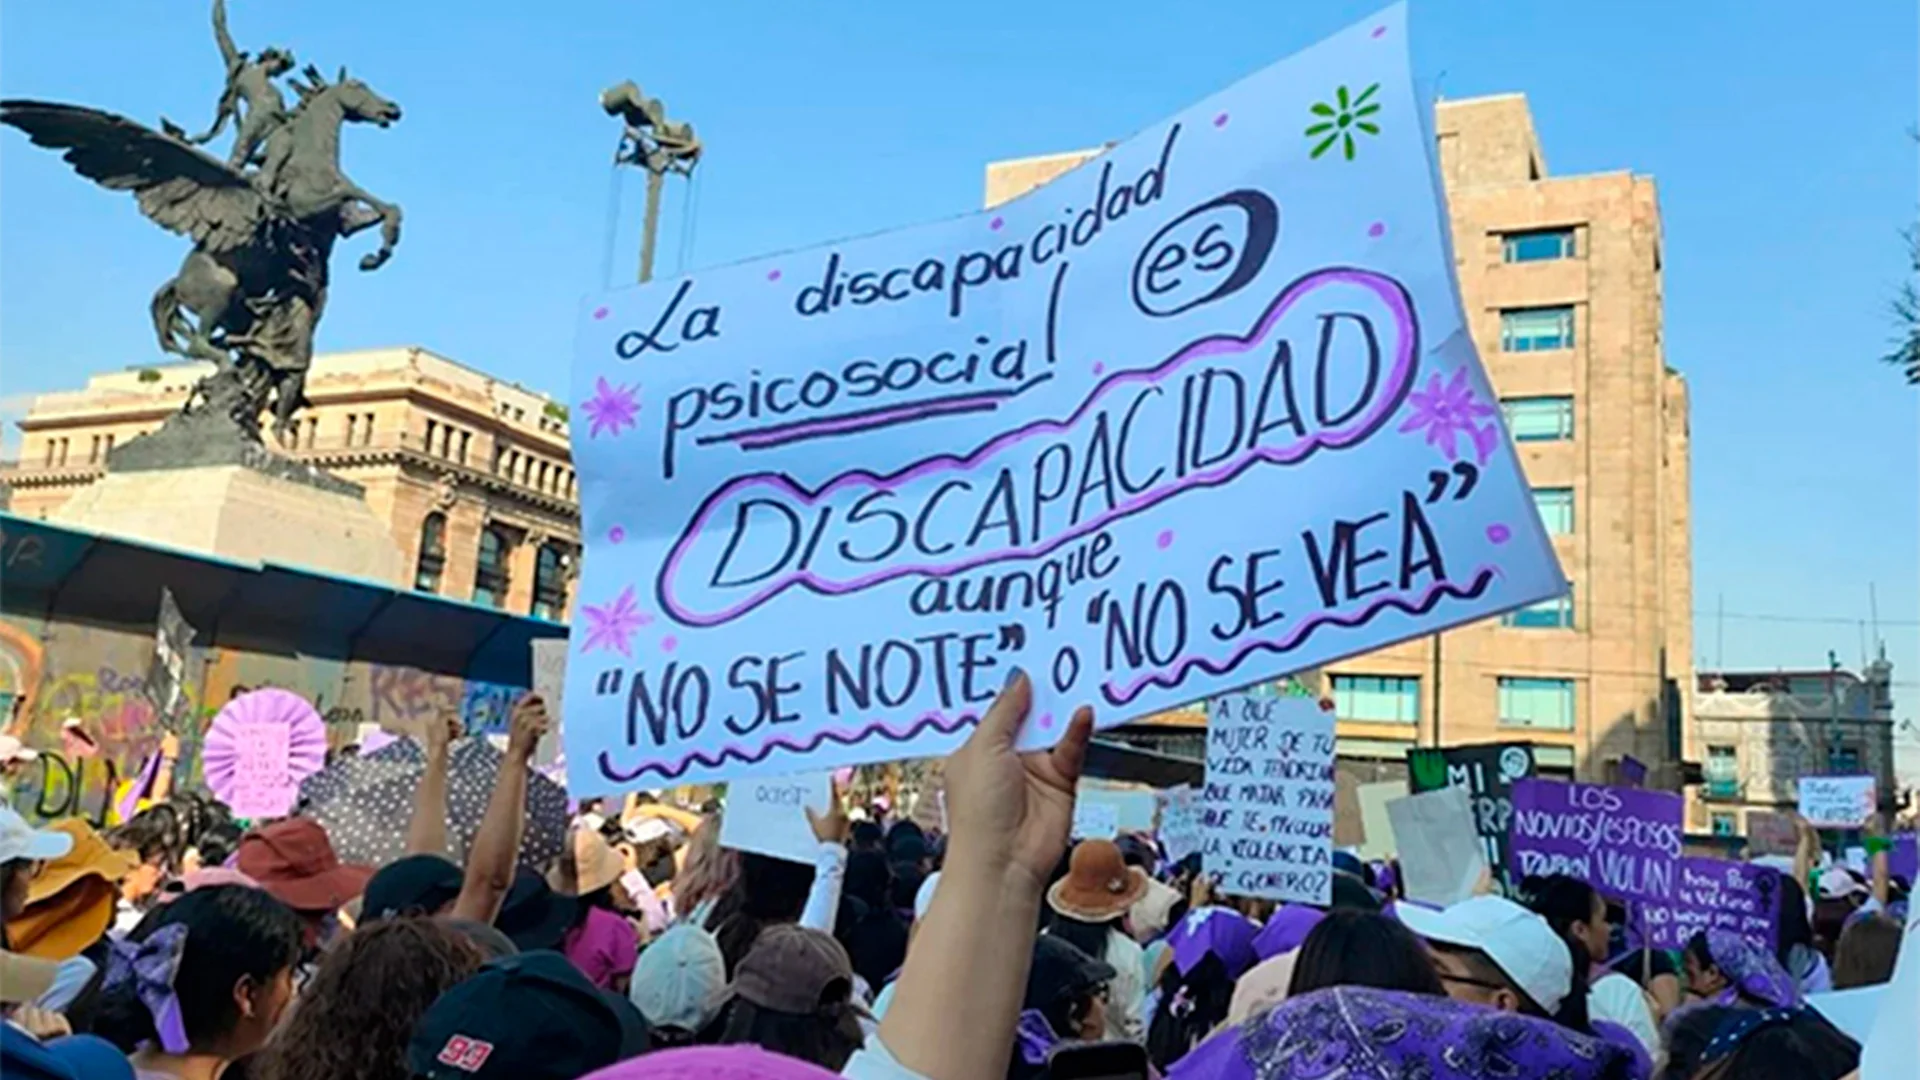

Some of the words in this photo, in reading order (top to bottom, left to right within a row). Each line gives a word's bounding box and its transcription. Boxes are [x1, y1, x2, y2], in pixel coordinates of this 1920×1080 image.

[616, 281, 720, 359] La
[796, 123, 1180, 316] discapacidad
[665, 262, 1070, 478] psicosocial
[1144, 221, 1233, 294] es
[710, 312, 1380, 588] DISCAPACIDAD
[909, 531, 1120, 630] aunque
[724, 650, 806, 736] SE
[1207, 549, 1285, 641] SE
[1207, 757, 1253, 776] VIDA
[1212, 725, 1269, 754] MUJER
[1569, 785, 1623, 812] LOS
[1597, 850, 1672, 899] VIOLAN
[439, 1034, 494, 1073] 93
